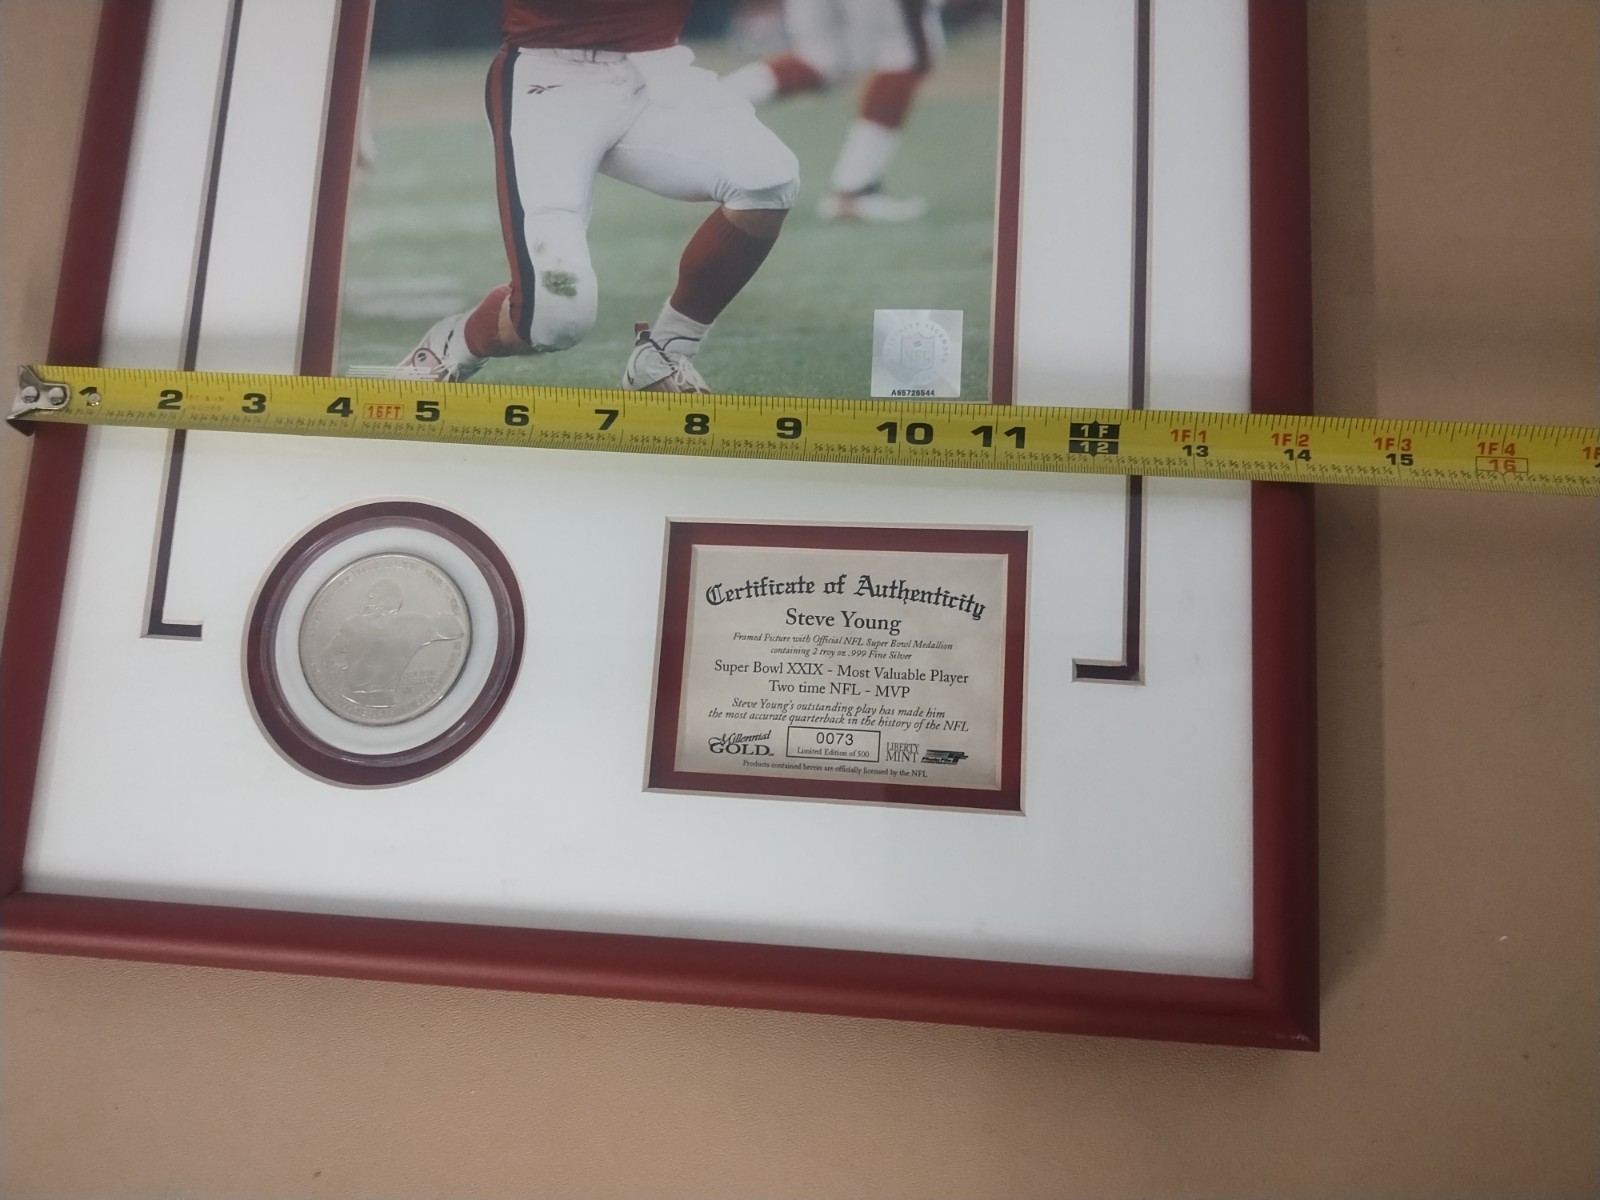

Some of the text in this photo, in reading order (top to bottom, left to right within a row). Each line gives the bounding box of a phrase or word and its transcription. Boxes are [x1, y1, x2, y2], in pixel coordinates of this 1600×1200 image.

[367, 405, 401, 419] 16FT
[157, 389, 183, 410] 2
[241, 393, 267, 414] 3
[326, 397, 353, 418] 4
[416, 400, 440, 422] 5
[505, 405, 530, 426] 6
[594, 409, 619, 431] 7
[684, 413, 710, 435] 8
[776, 417, 802, 439] 9
[876, 421, 934, 445] 10
[971, 425, 1026, 449] 11
[1080, 441, 1109, 453] 12
[1182, 445, 1209, 457] 13
[1284, 449, 1312, 461] 14
[1386, 453, 1414, 467] 15
[1489, 458, 1516, 472] 16
[706, 574, 986, 621] Certificate of Authenticity
[786, 607, 902, 636] Steve Young
[733, 632, 953, 650] Framed Picture with Official NFL Super Bowl Medallion
[771, 645, 810, 657] containing
[819, 648, 835, 659] troy
[868, 650, 887, 659] Fine
[889, 651, 912, 660] Silver
[714, 659, 749, 676] Super
[753, 661, 783, 674] Bowl
[786, 662, 824, 675] XXIX
[837, 665, 870, 679] Most
[874, 666, 926, 681] Valuable
[930, 669, 969, 687] Player
[768, 679, 795, 692] Two
[799, 681, 826, 694] time
[830, 682, 861, 695] NFL
[875, 685, 910, 698] MVP
[732, 697, 946, 718] Steve Young's outstanding play has made him
[708, 708, 969, 732] the most accurate quarterback in the history of the NFL
[708, 730, 771, 746] Millennial
[816, 731, 853, 746] 0073
[710, 743, 771, 756] GOLD
[797, 746, 822, 755] Limited
[824, 748, 848, 757] Edition
[857, 750, 870, 758] 500
[886, 750, 917, 763] MINT
[887, 742, 920, 755] LIBERTY
[743, 760, 770, 768] Products
[771, 762, 801, 770] contained
[890, 769, 898, 777] by
